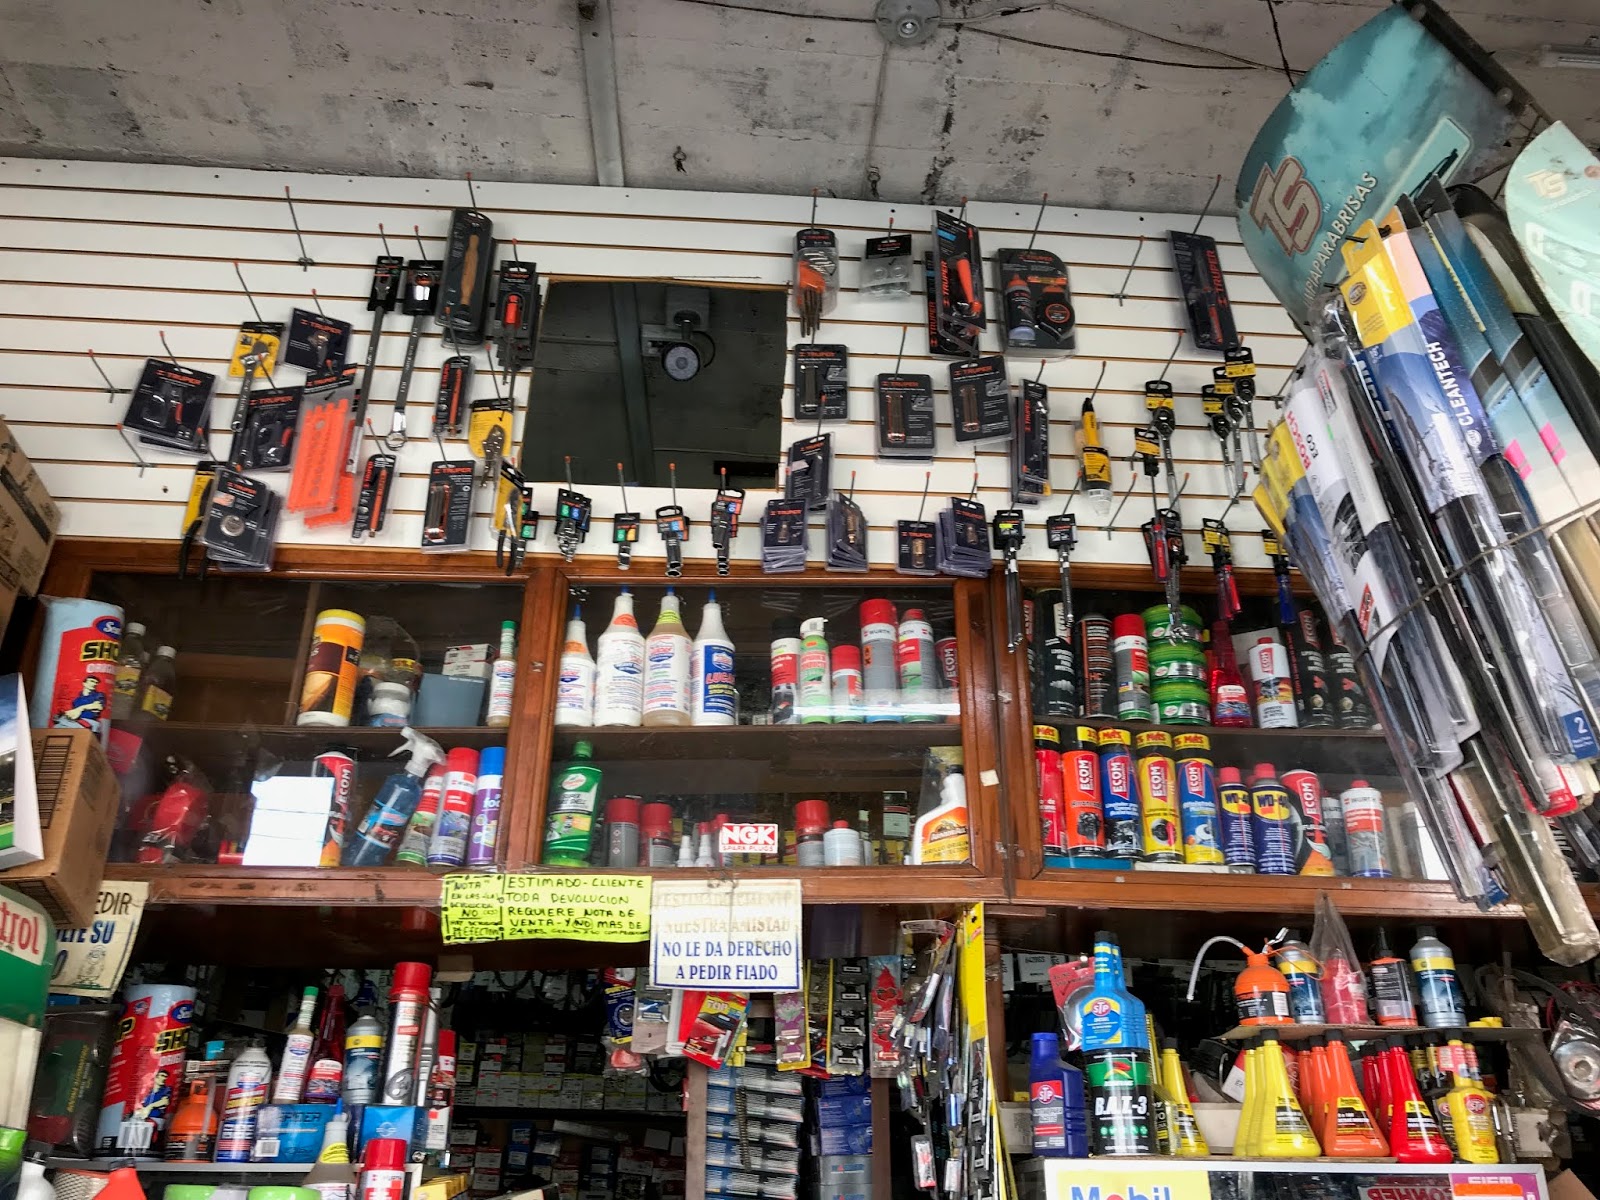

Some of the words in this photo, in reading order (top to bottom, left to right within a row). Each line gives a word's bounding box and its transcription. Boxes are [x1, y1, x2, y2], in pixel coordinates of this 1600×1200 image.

[941, 260, 949, 296] TRUPER
[1207, 250, 1225, 293] TRUPER
[928, 301, 937, 336] TRUPER
[309, 320, 344, 335] TRUPER
[166, 371, 203, 386] TRUPER
[963, 365, 993, 376] TRUPER
[889, 380, 920, 388] TRUPER
[1425, 340, 1475, 427] CLEANTECH
[259, 394, 294, 405] TRUPER
[1285, 410, 1312, 470] BOSCH
[1306, 433, 1319, 459] ECO
[442, 466, 473, 474] TRUPER
[944, 648, 955, 680] ECOM
[1573, 715, 1588, 735] 2
[1076, 758, 1090, 791] ECOM
[1110, 761, 1123, 793] ECOM
[1151, 766, 1163, 798] ECOM
[1189, 767, 1200, 793] ECOM
[340, 769, 351, 804] ECOM
[1225, 792, 1249, 803] WD-4
[1301, 781, 1317, 816] ECOM
[722, 825, 776, 845] NGK
[508, 877, 580, 888] ESTIMADO
[592, 878, 645, 889] CLIENTE
[95, 891, 135, 915] EDIR
[506, 893, 540, 902] TODA
[552, 893, 629, 905] DEVOLUCION
[461, 908, 479, 918] NO
[508, 906, 575, 917] REQUIERE
[584, 908, 614, 918] NOTA
[619, 909, 636, 918] DE
[90, 920, 116, 944] SU
[509, 928, 524, 936] 24
[510, 918, 555, 928] VENTA
[573, 919, 592, 929] NO
[596, 920, 623, 929] MAS
[629, 921, 643, 930] DE
[662, 941, 681, 957] NO
[686, 941, 700, 957] LE
[705, 941, 723, 957] DA
[728, 940, 792, 957] DERECHO
[675, 965, 685, 980] A
[689, 964, 732, 980] PEDIR
[736, 964, 778, 980] FIADO
[706, 999, 729, 1011] TOP
[1091, 1000, 1110, 1016] STP
[1038, 1086, 1054, 1104] STP
[1465, 1098, 1487, 1115] STP
